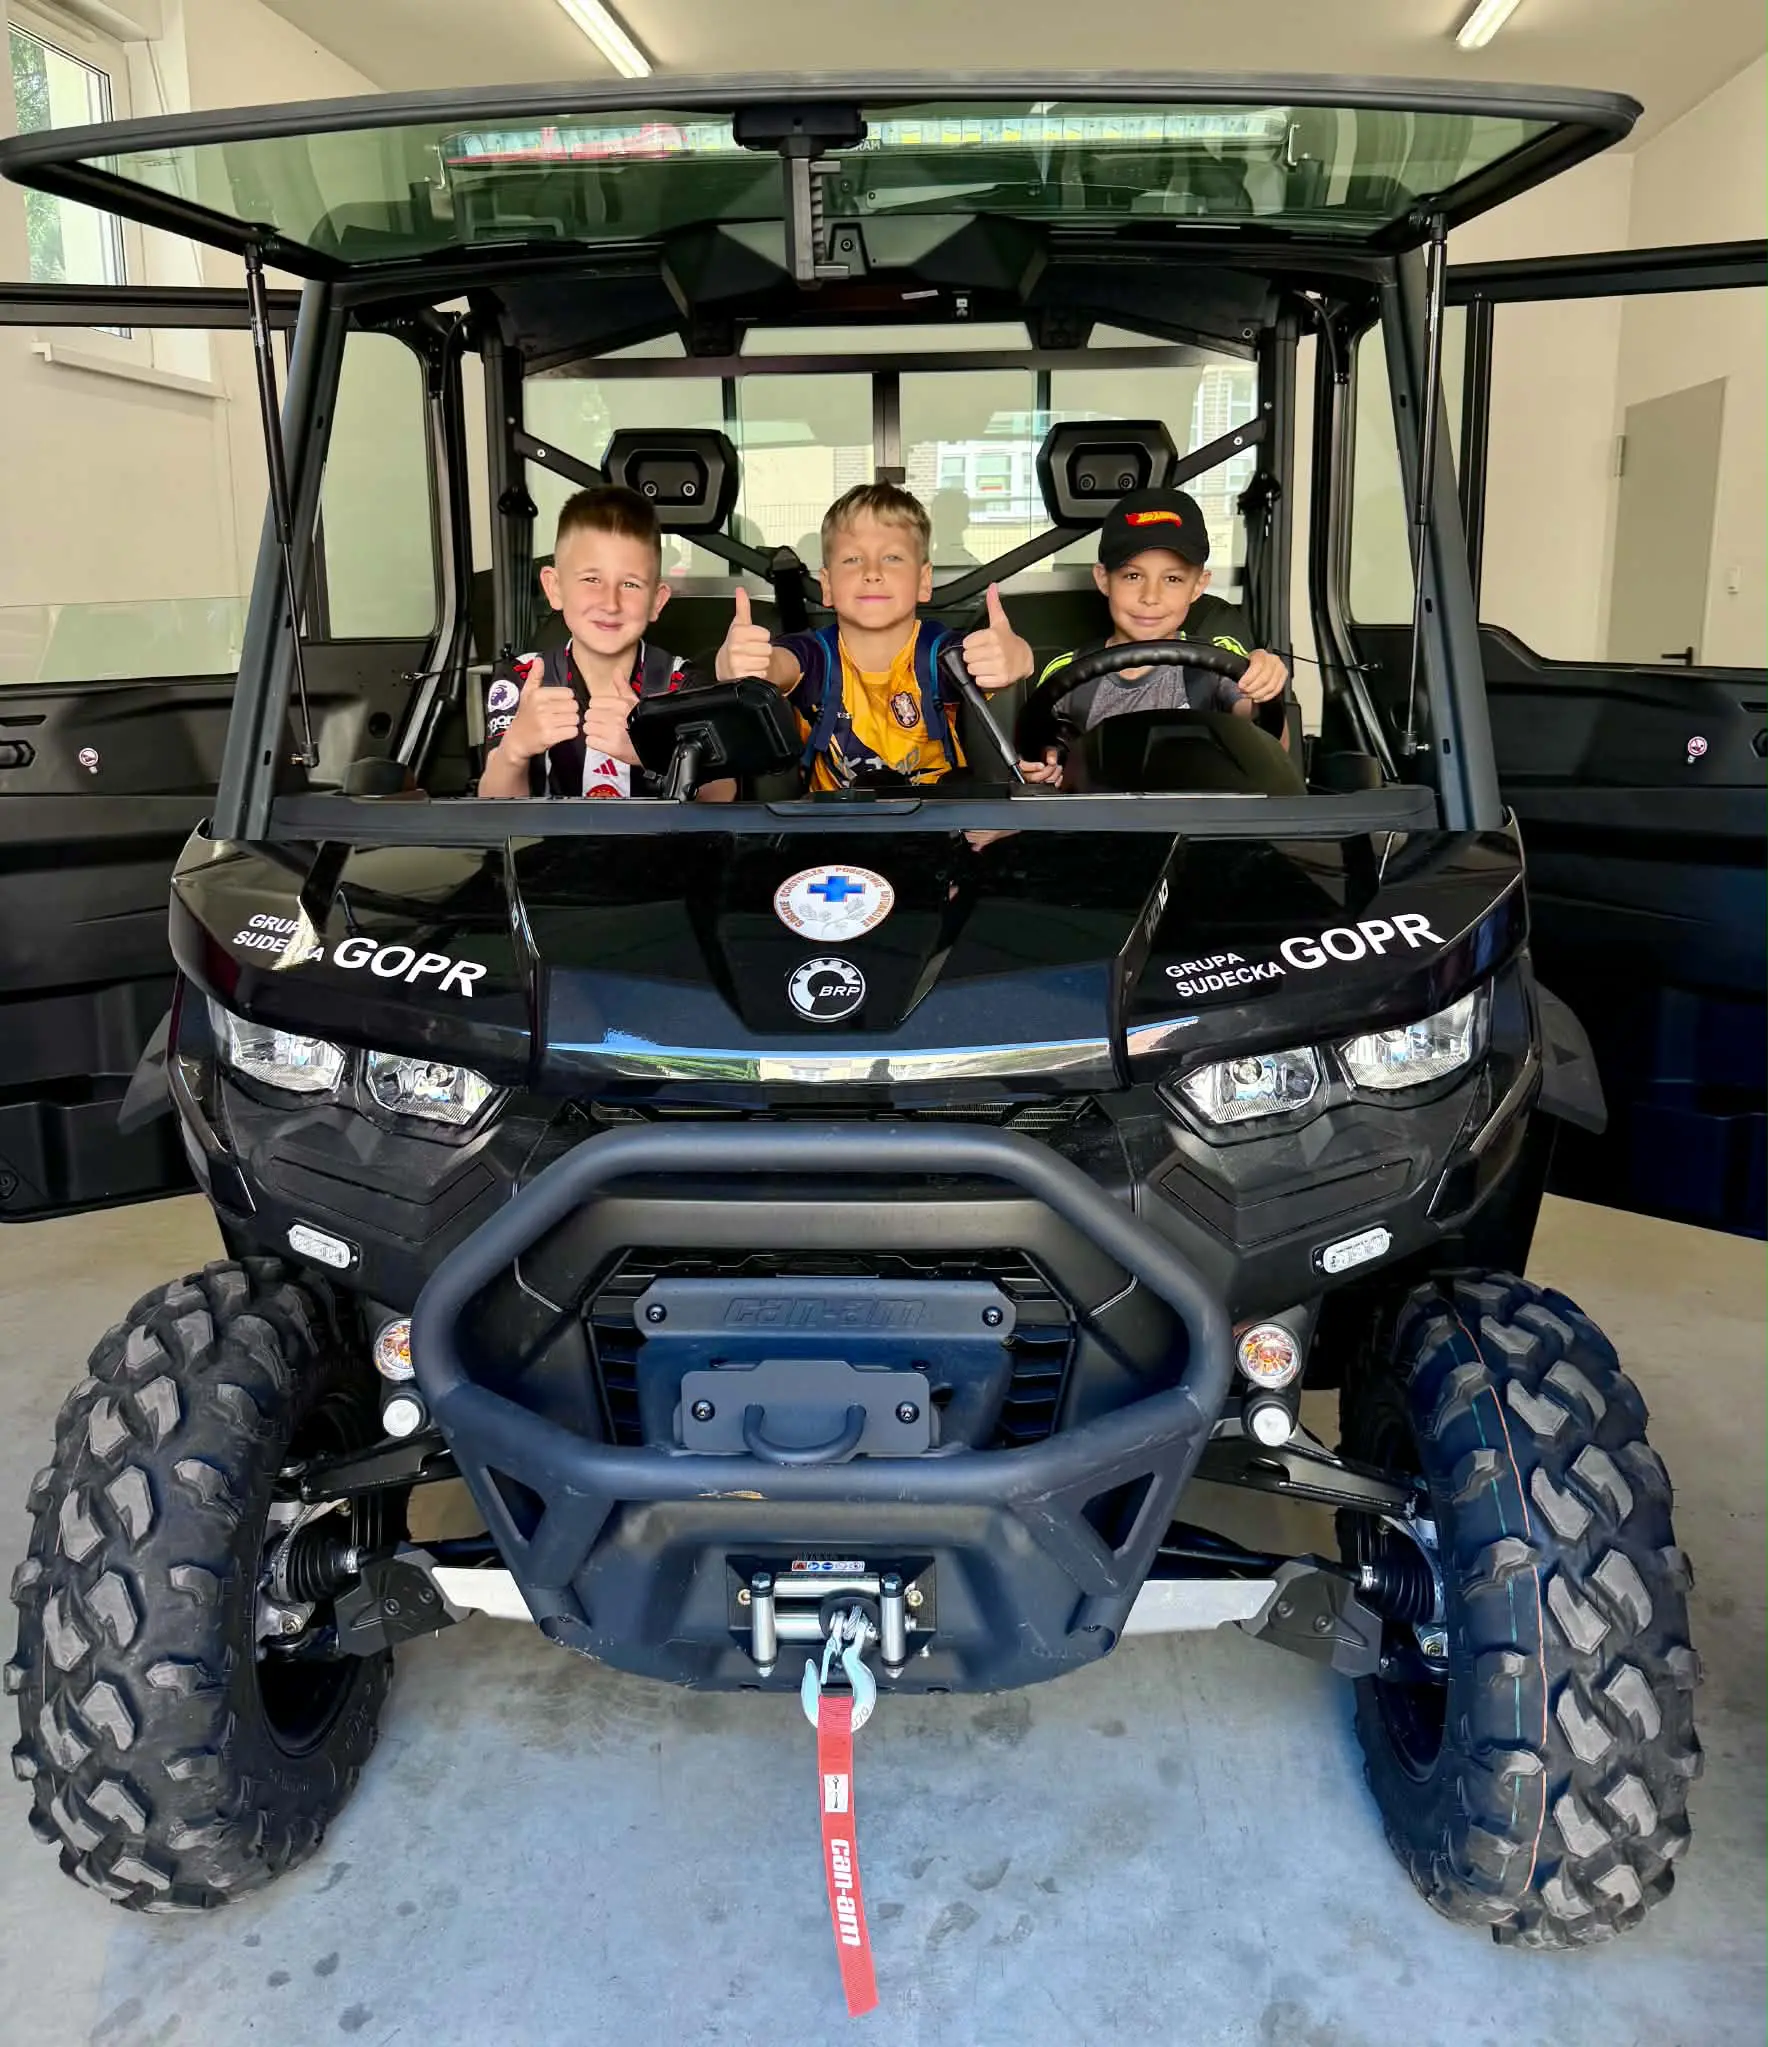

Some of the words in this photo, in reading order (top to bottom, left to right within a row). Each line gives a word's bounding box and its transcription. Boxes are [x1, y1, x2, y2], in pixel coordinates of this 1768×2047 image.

[248, 914, 317, 937] GRUP
[1279, 913, 1447, 970] GOPR
[333, 937, 487, 997] GOPR
[1165, 952, 1246, 978] GRUPA
[1175, 961, 1287, 997] SUDECKA
[819, 985, 860, 997] BRP
[830, 1838, 861, 1947] can-am
